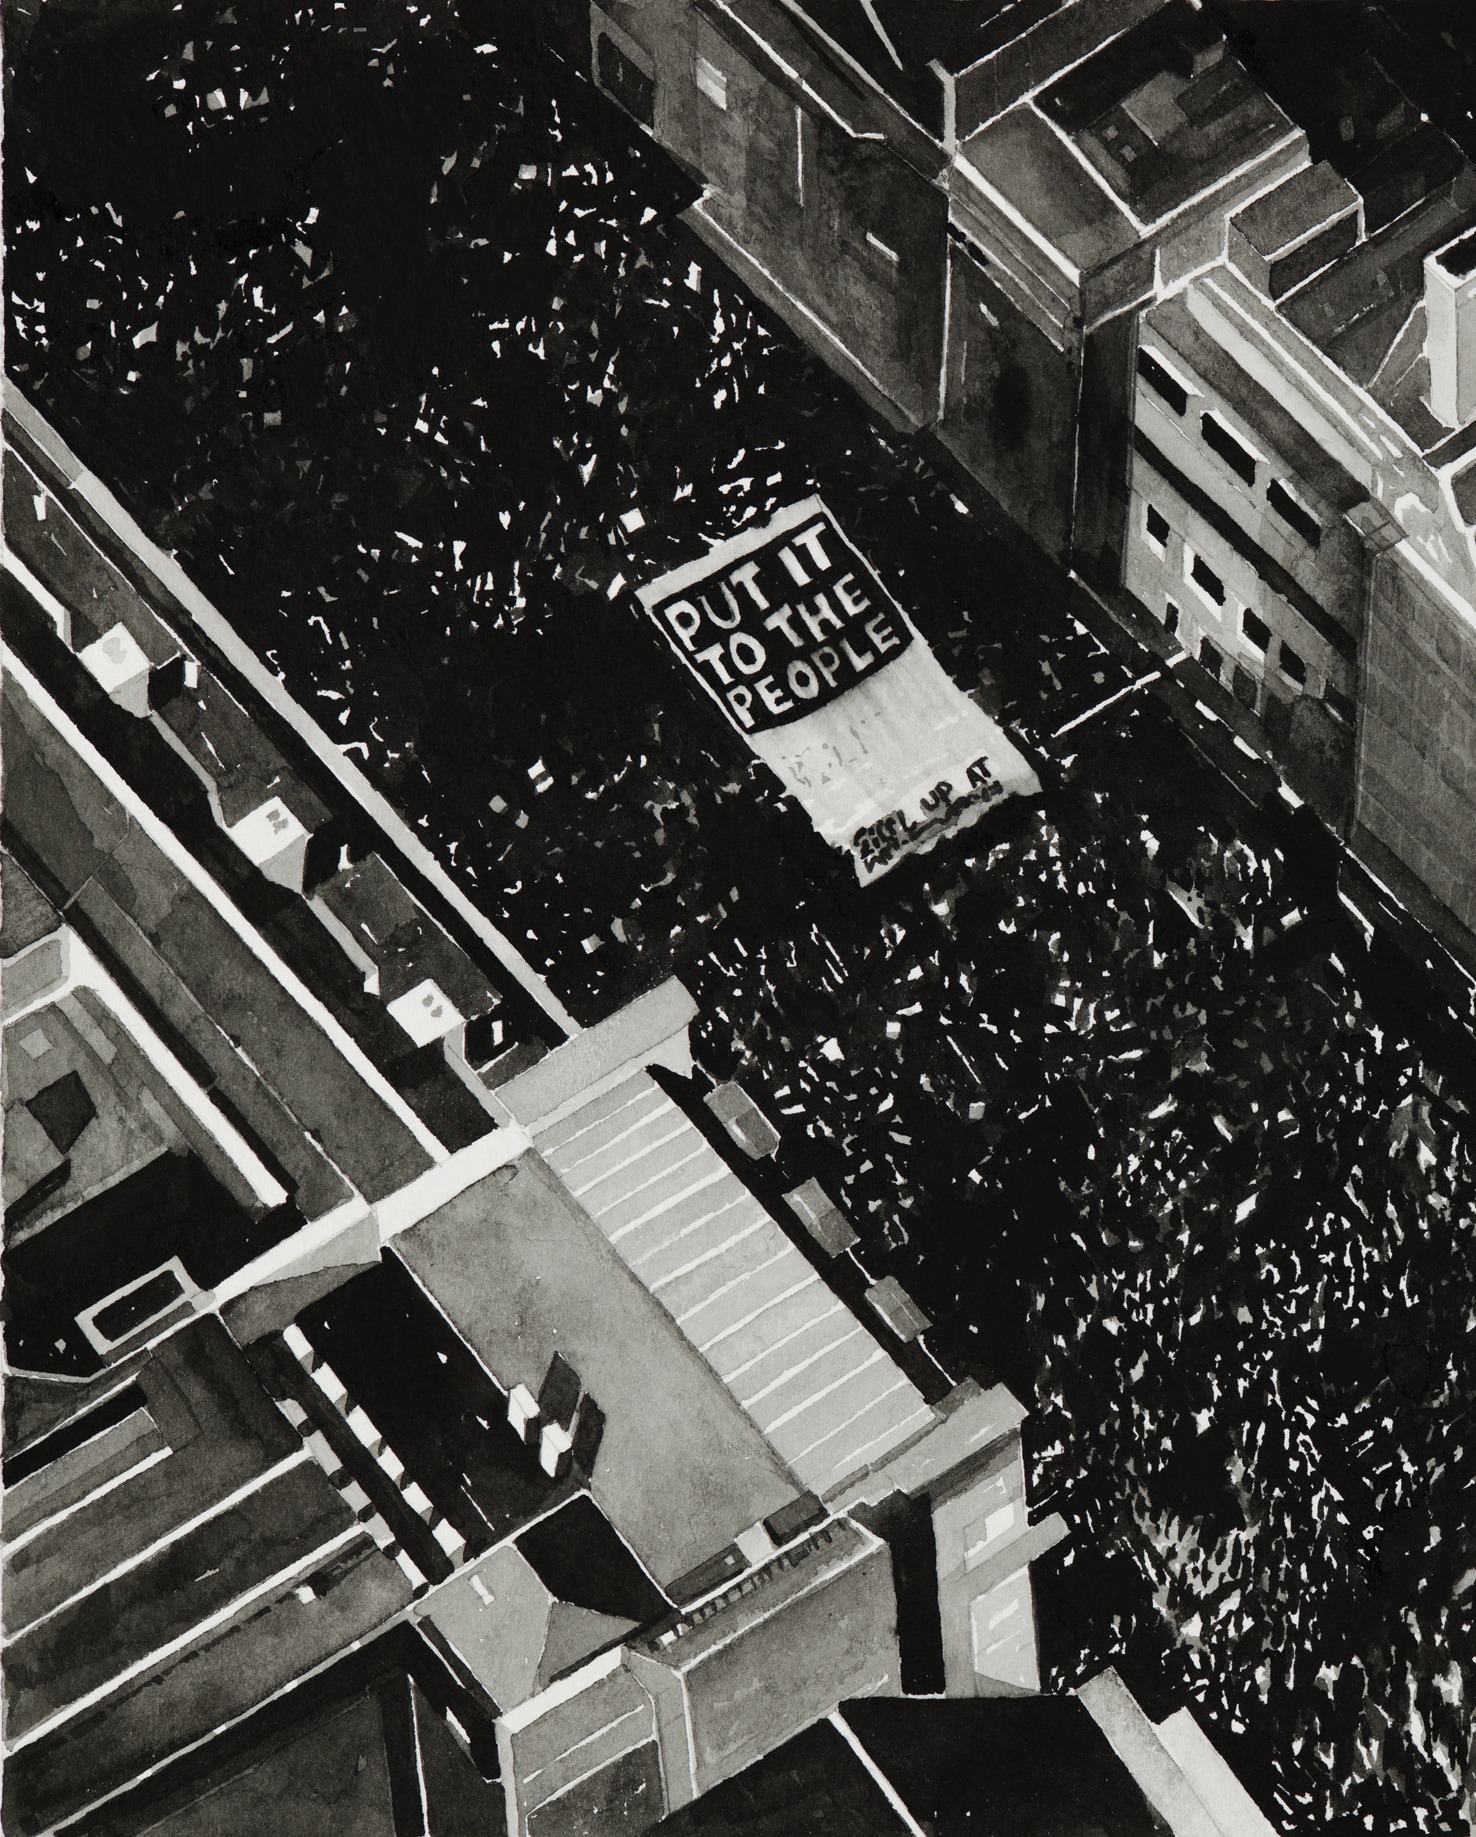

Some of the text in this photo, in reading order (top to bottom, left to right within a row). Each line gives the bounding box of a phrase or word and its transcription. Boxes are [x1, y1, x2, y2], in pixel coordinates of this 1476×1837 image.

[664, 522, 832, 652] PUT IT
[694, 572, 872, 685] TO THE
[726, 612, 901, 729] PEOPLE
[966, 756, 992, 789] AT
